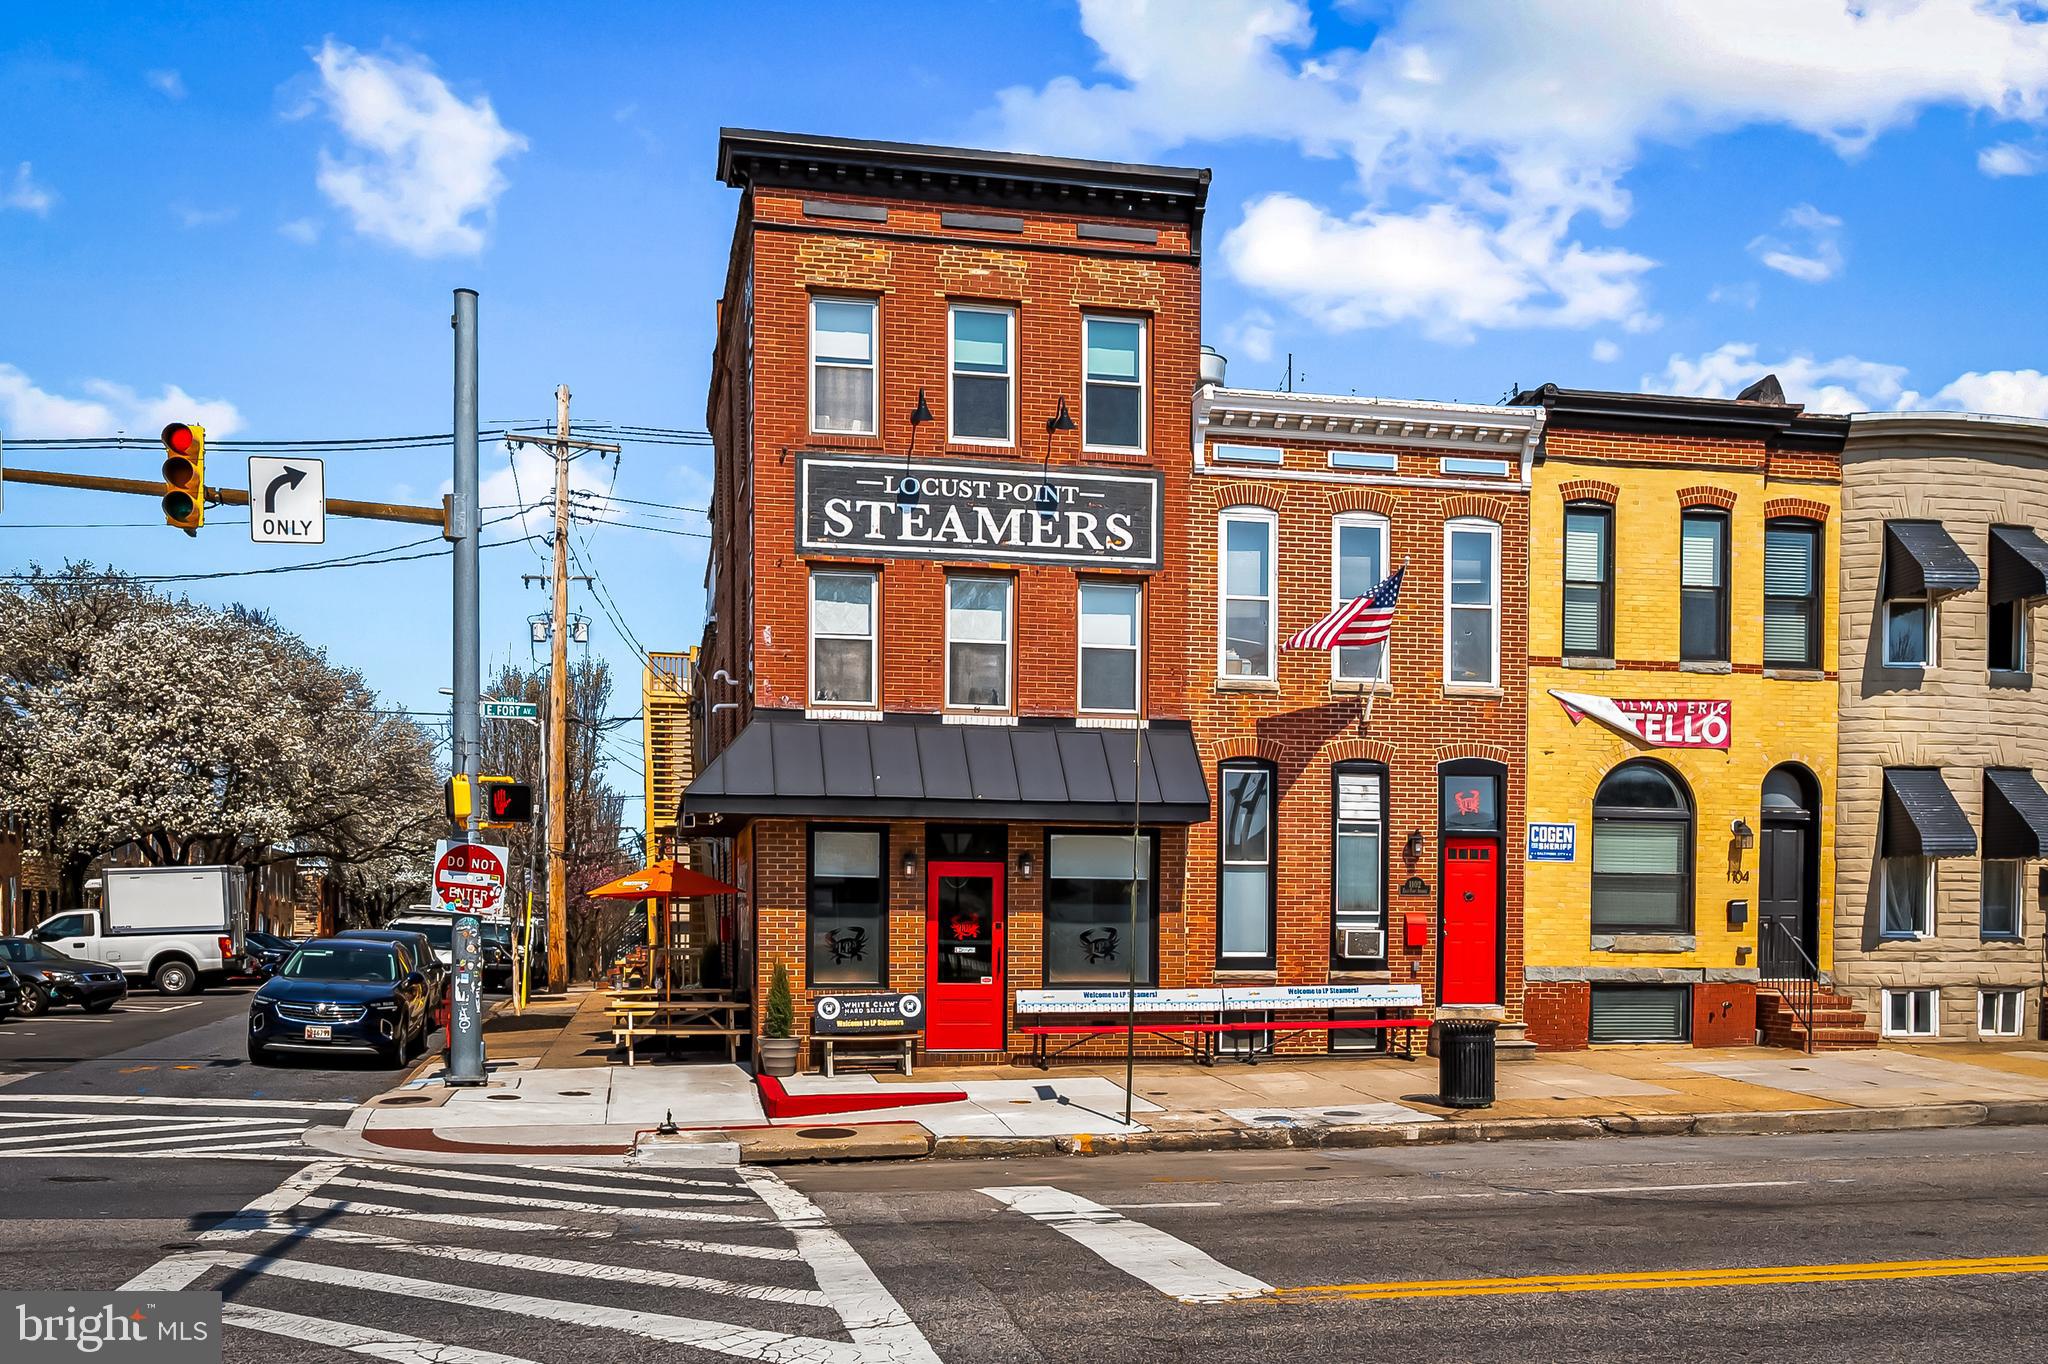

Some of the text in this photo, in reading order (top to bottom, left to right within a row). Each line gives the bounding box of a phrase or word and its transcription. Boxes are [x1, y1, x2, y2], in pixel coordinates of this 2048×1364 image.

[884, 475, 1079, 504] LOCUST POINT
[263, 519, 312, 536] ONLY
[823, 498, 1134, 551] STEAMERS
[497, 705, 520, 716] FORT
[1621, 701, 1678, 713] ILMAN
[1624, 713, 1728, 745] TELLO
[1531, 826, 1573, 843] COGEN
[447, 856, 496, 871] DO NOT
[1727, 870, 1749, 884] 1104
[449, 886, 488, 901] ENTER
